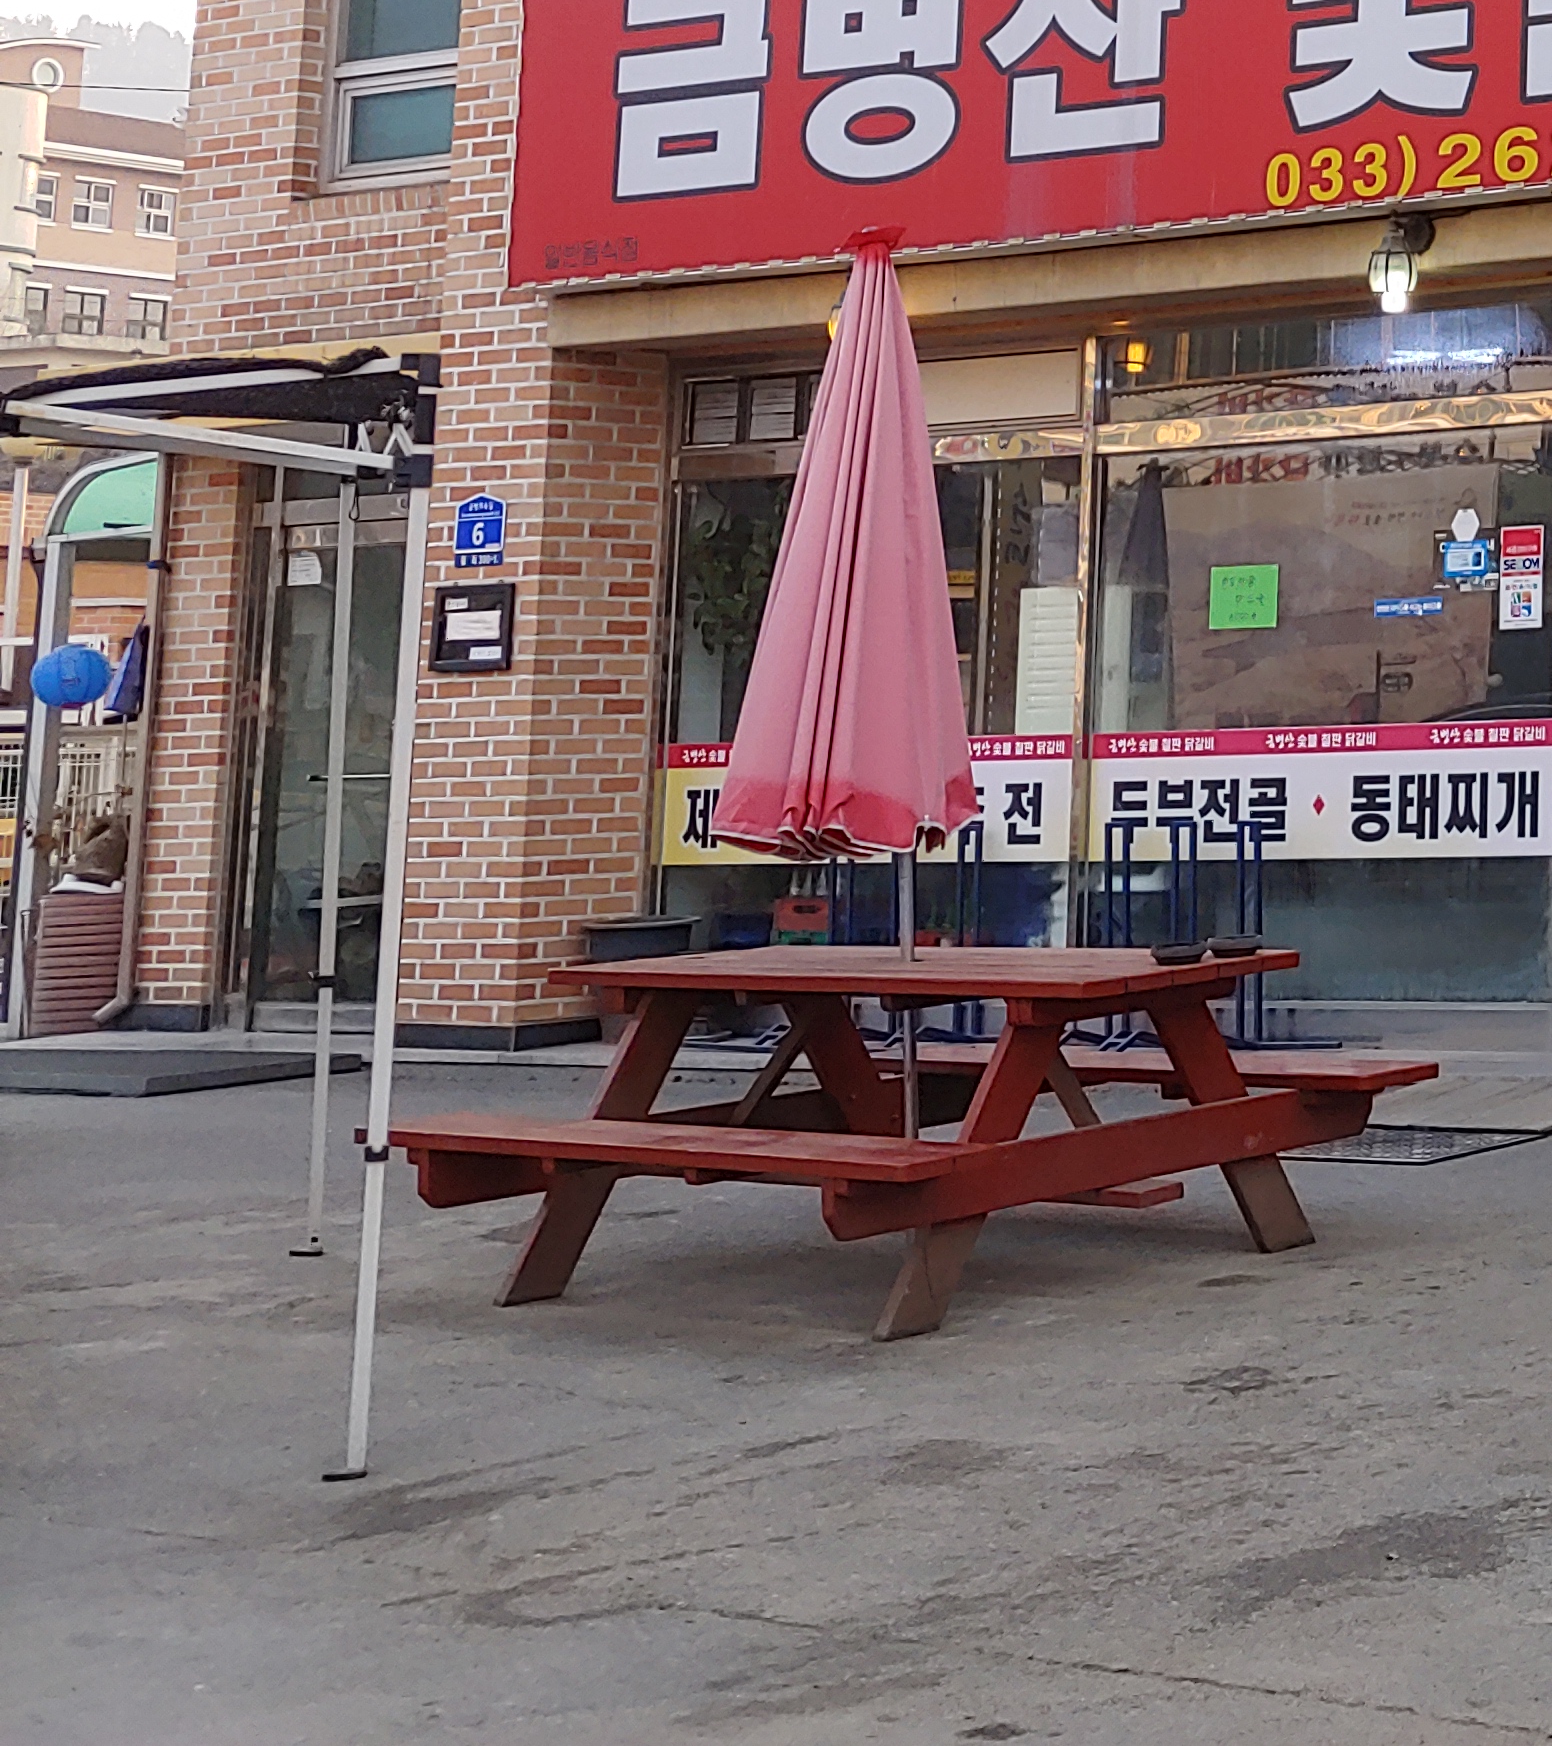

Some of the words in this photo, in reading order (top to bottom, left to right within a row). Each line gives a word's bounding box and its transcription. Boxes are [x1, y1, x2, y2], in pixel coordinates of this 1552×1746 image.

[472, 522, 485, 546] 6
[1503, 558, 1540, 570] SEOM
[1345, 731, 1377, 747] 닭갈비
[1513, 725, 1546, 742] 닭갈비
[1184, 736, 1215, 752] 닭갈비
[1110, 777, 1288, 845] 두부전골
[1350, 771, 1541, 843] 동태찌개
